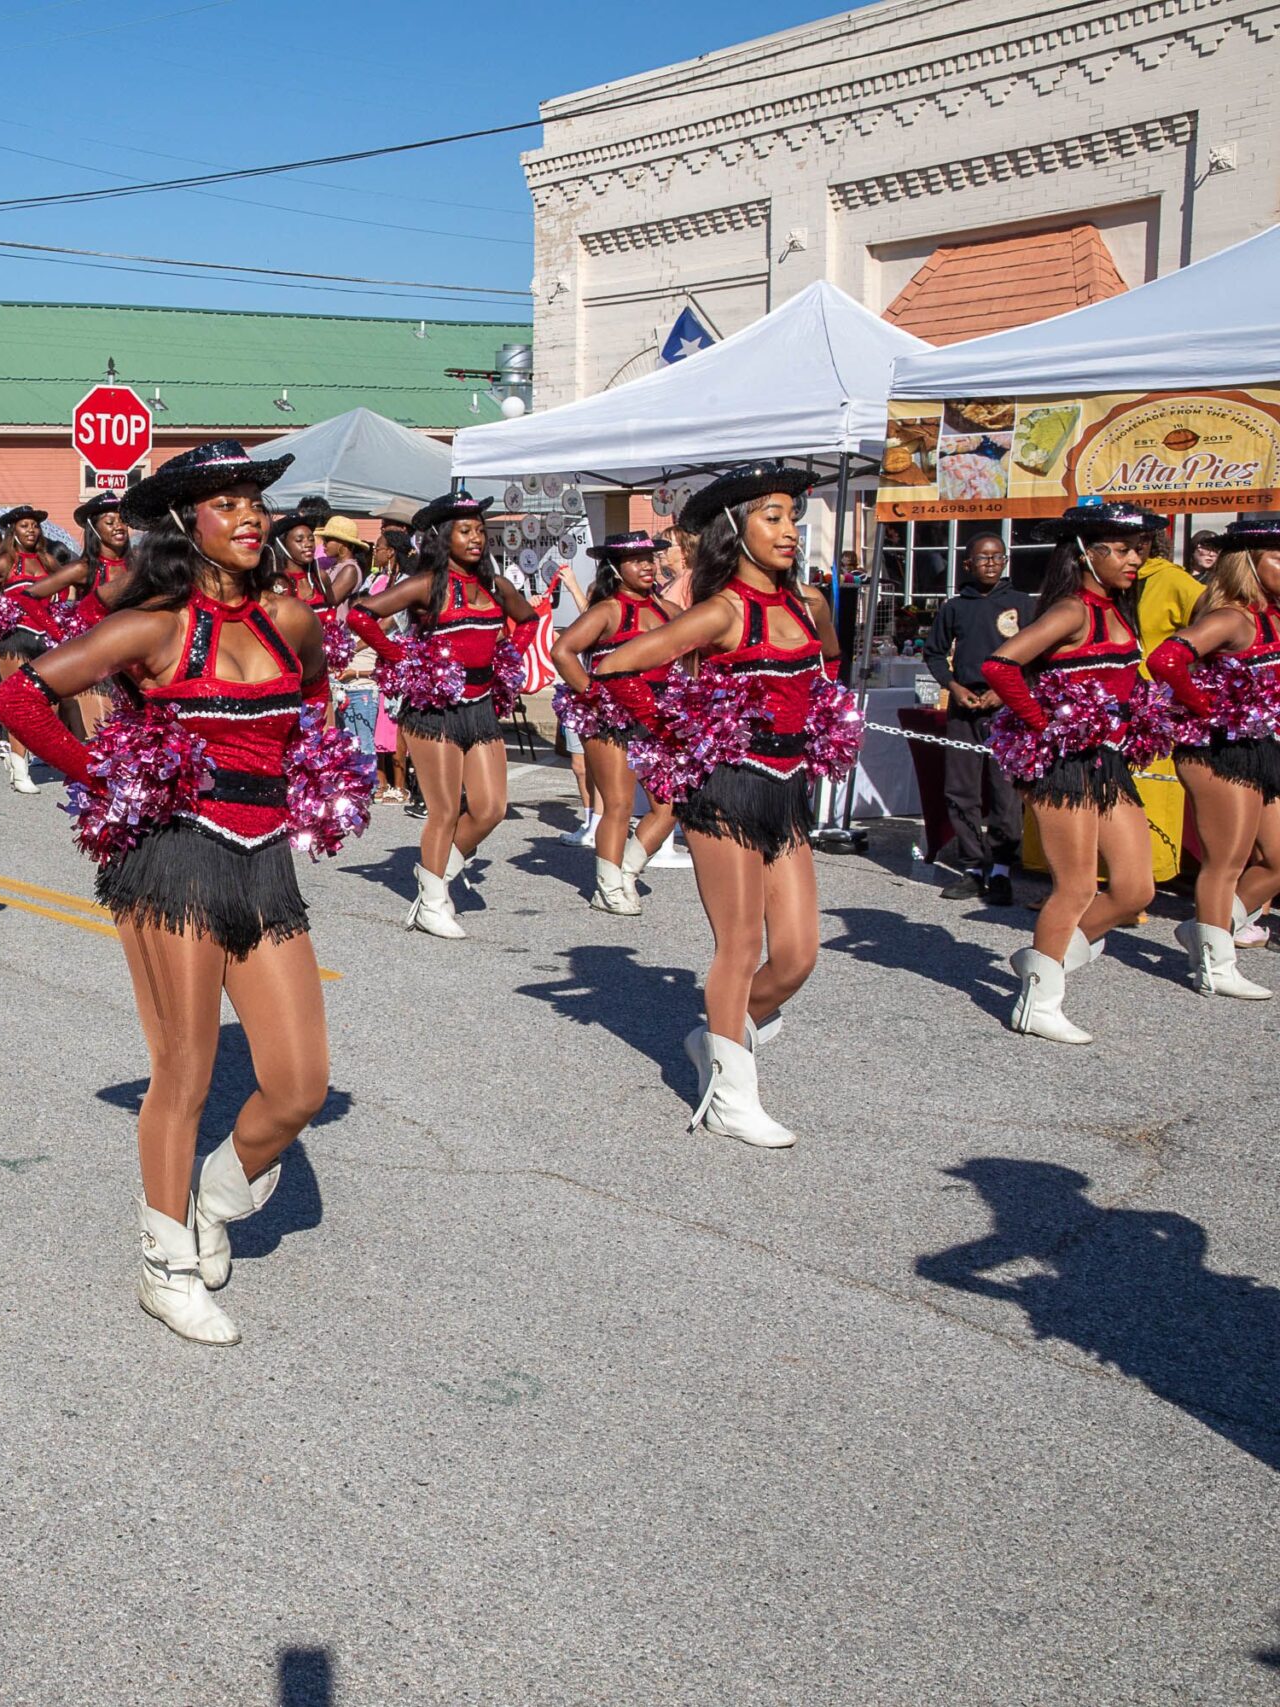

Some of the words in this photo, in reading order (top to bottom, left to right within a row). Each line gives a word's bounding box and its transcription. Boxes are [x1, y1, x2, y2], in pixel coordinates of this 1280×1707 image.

[1170, 408, 1201, 416] FROM
[1206, 410, 1228, 419] THE
[78, 412, 146, 446] STOP
[1203, 434, 1233, 442] 2015
[1095, 453, 1179, 492] Nita
[1182, 453, 1260, 482] Pies
[98, 476, 125, 488] 4-WAY
[1142, 482, 1190, 491] SWEET
[1196, 480, 1252, 488] TREATS
[1108, 495, 1274, 508] APIESANDSWEETS
[911, 503, 1003, 514] 214.698.9140
